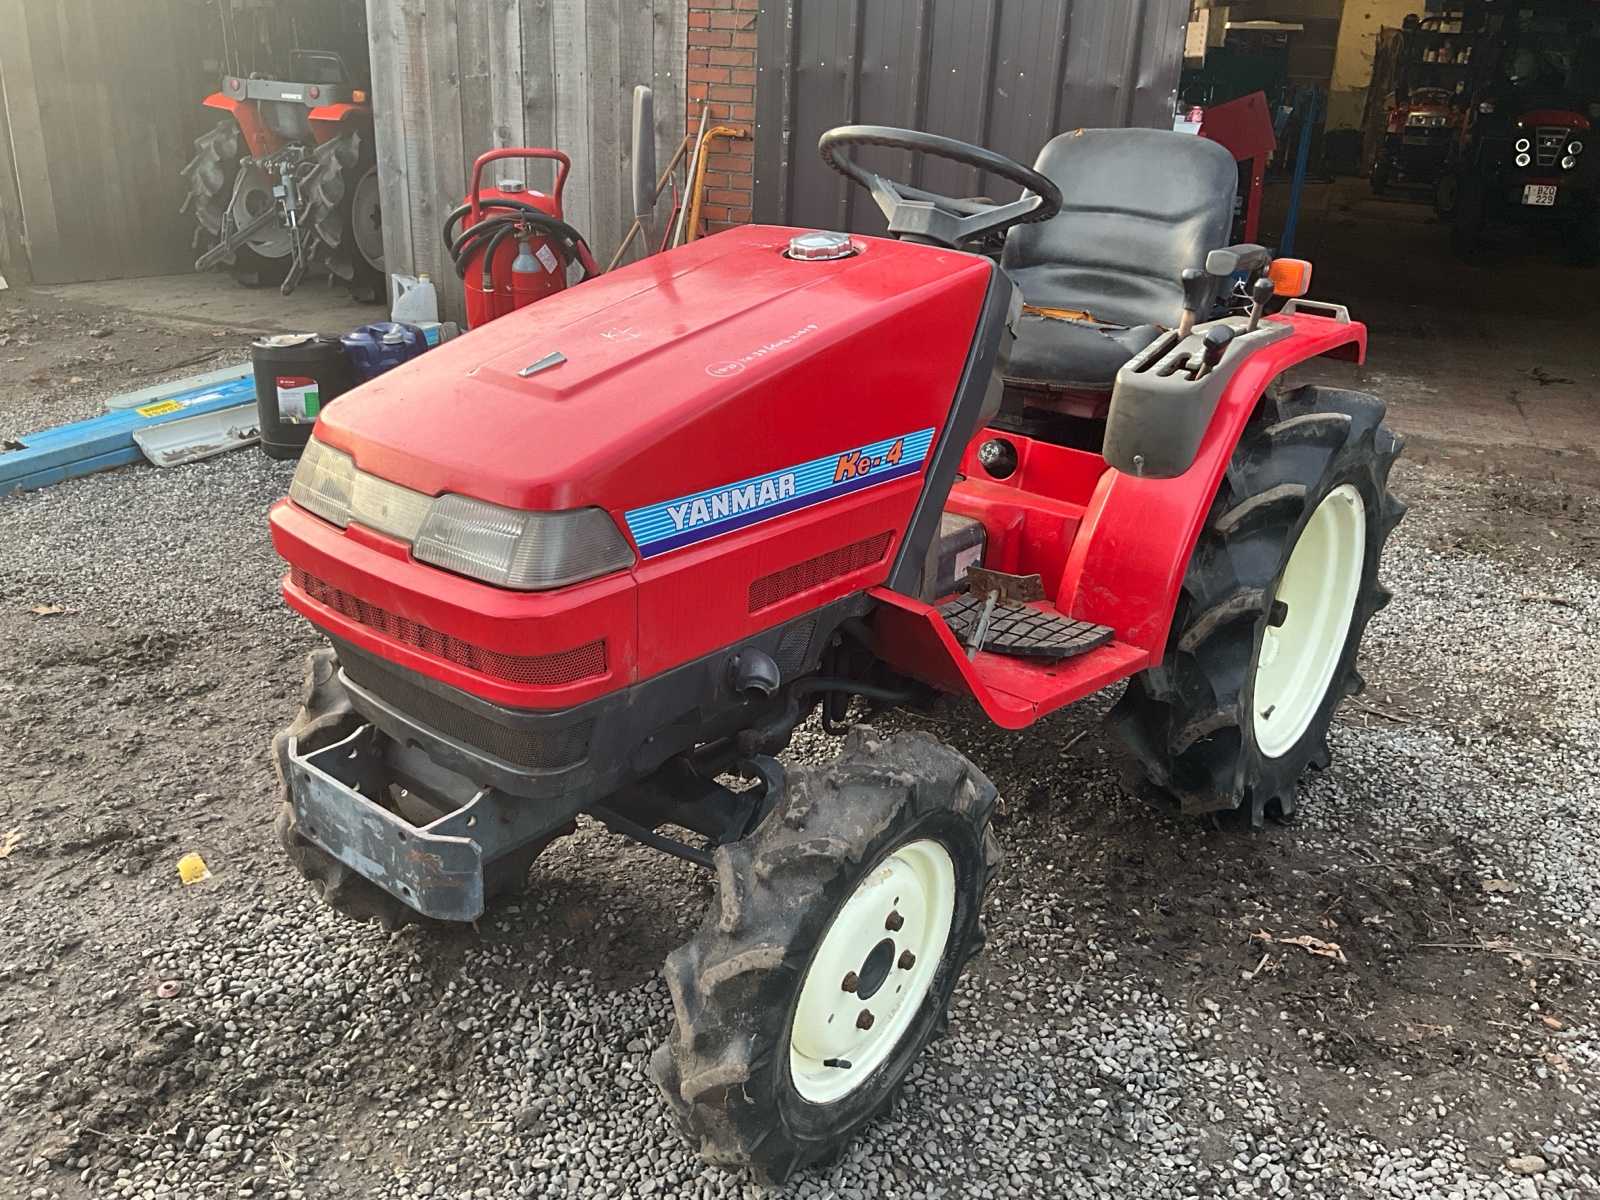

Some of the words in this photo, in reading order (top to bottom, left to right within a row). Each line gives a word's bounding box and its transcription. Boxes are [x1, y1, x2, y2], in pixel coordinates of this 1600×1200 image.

[1535, 195, 1554, 204] 229
[667, 473, 797, 531] YANMAR
[833, 439, 904, 483] Ke-4
